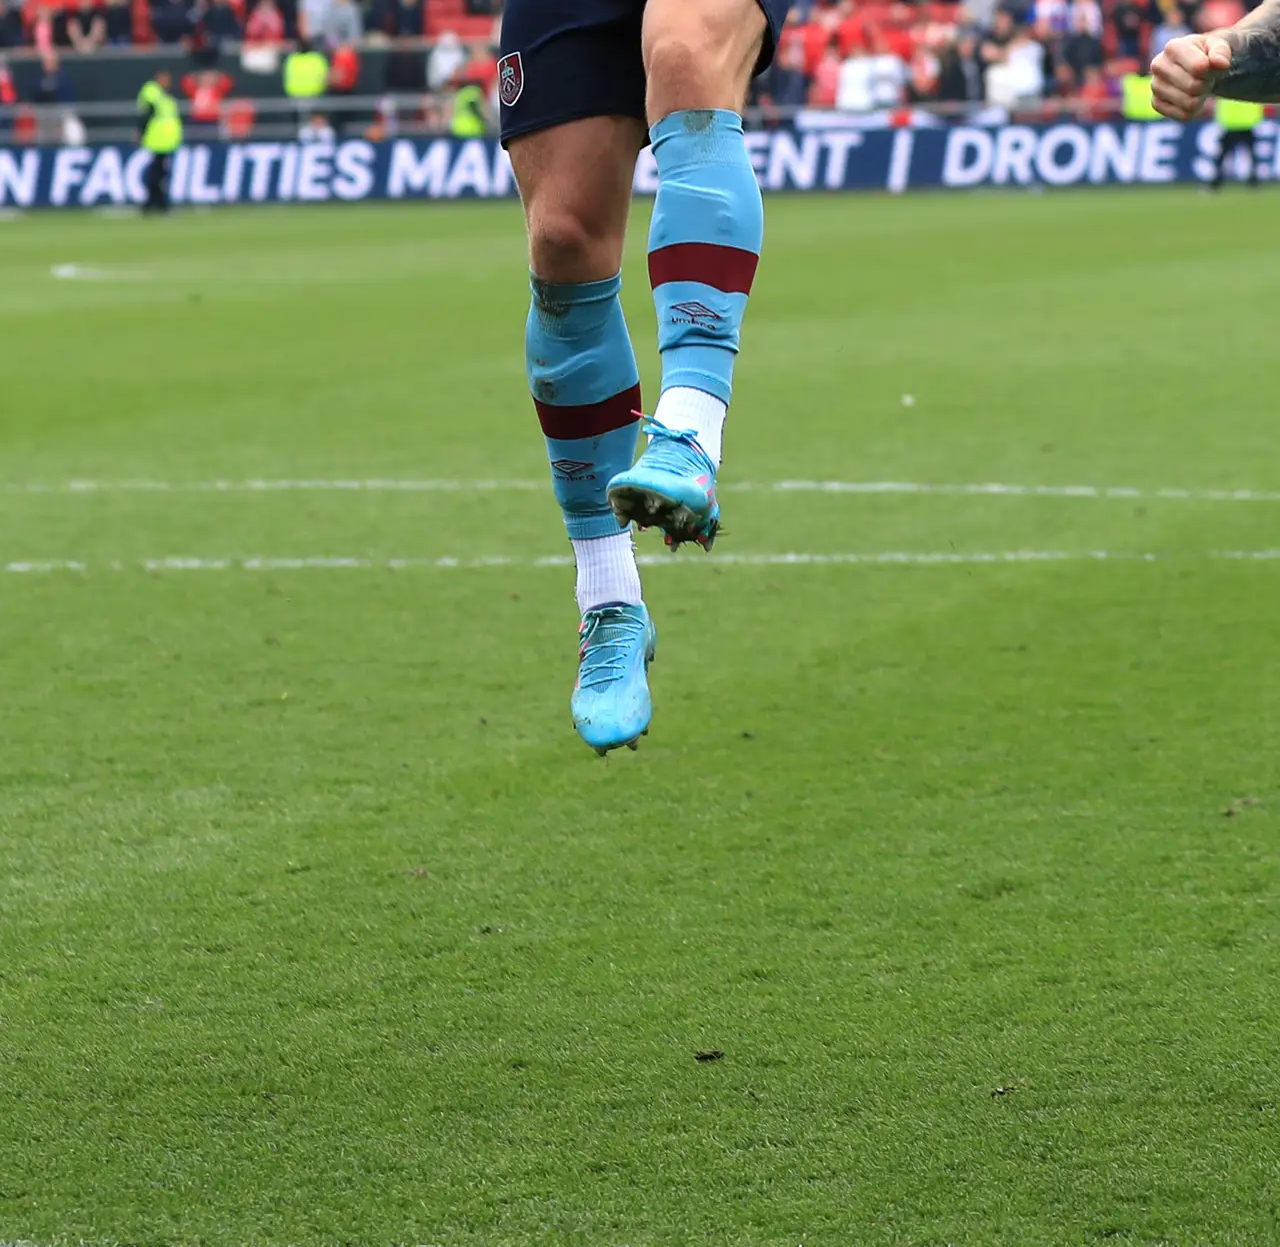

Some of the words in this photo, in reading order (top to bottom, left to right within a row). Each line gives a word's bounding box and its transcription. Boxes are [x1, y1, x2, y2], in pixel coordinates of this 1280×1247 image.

[50, 140, 376, 206] FACILITIES
[941, 121, 1183, 186] DRONE
[671, 315, 716, 330] umbro
